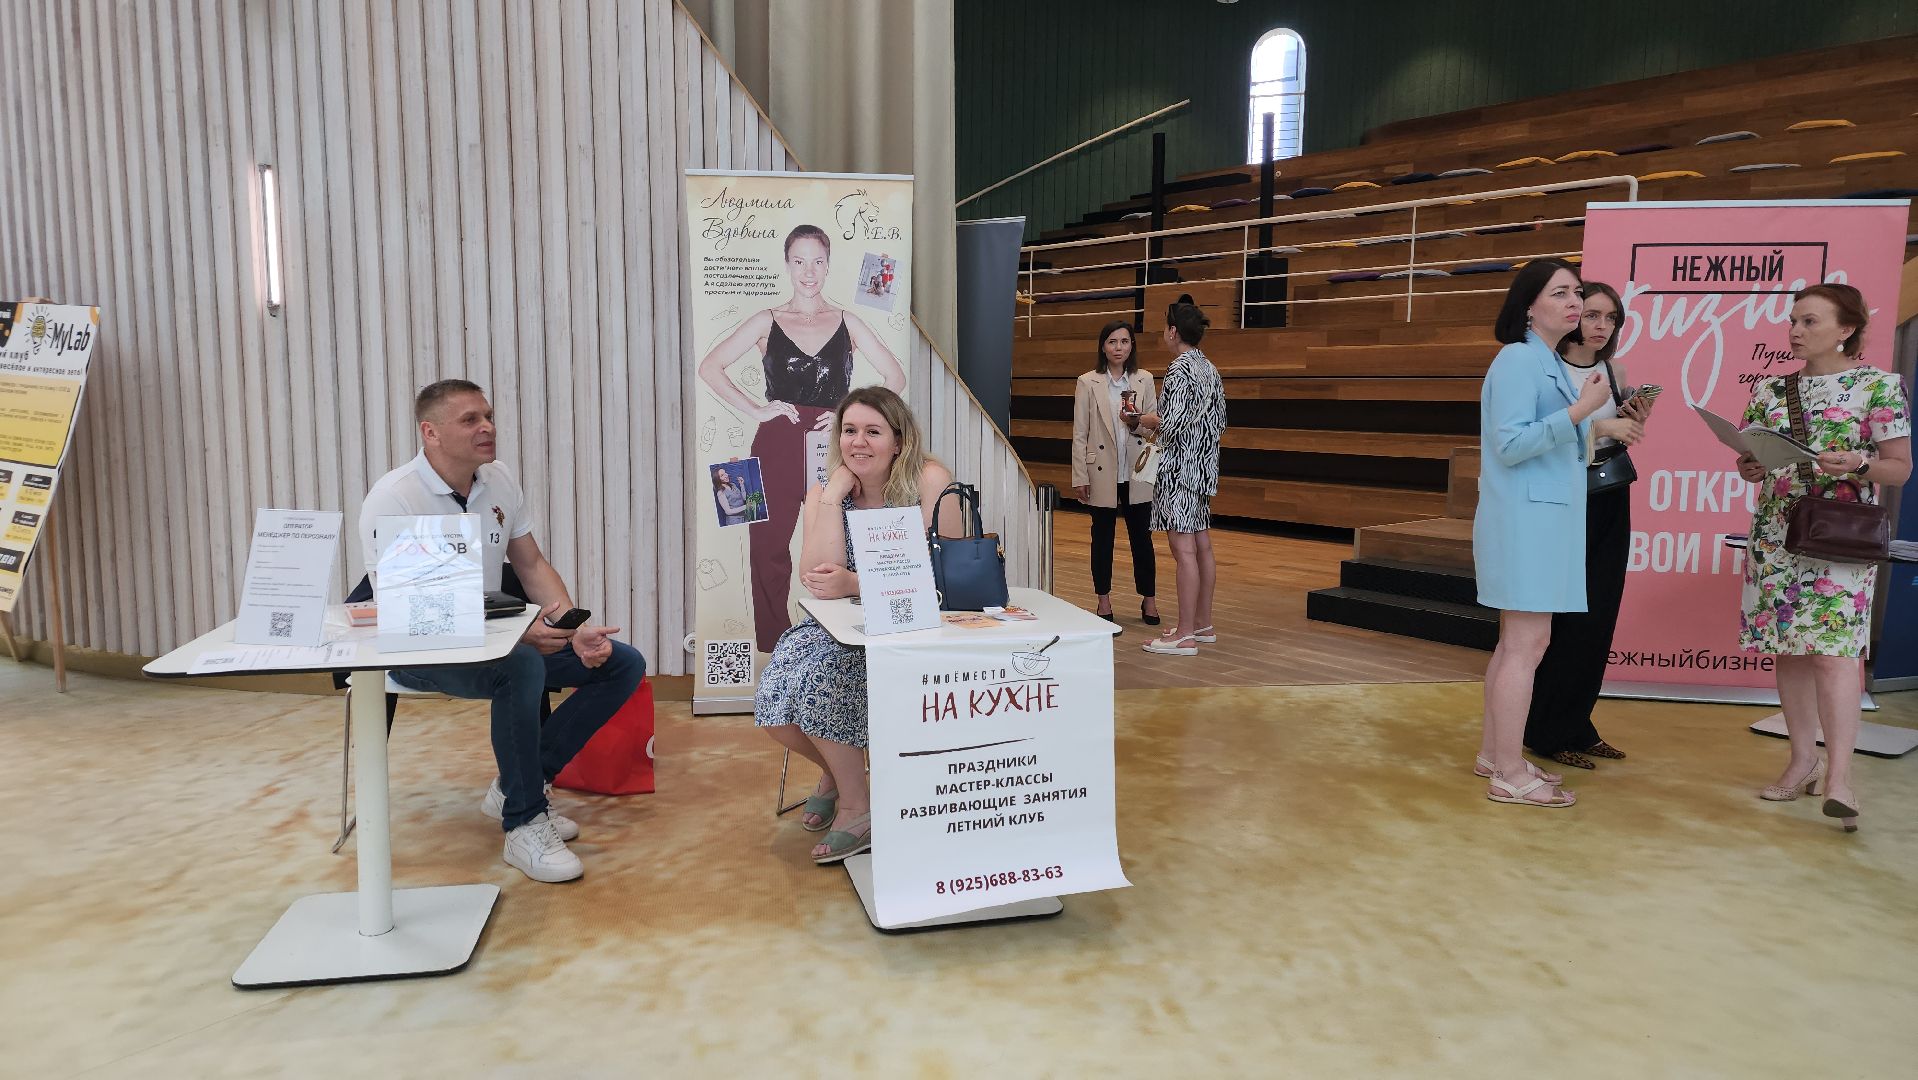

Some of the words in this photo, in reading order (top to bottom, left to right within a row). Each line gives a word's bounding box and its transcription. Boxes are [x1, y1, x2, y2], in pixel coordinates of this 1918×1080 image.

[700, 187, 796, 221] Людмила
[702, 214, 779, 251] Вдовина
[1671, 249, 1785, 282] НЕЖНЫЙ
[49, 322, 91, 356] MyLab
[1837, 393, 1851, 403] 33
[489, 532, 500, 544] 13
[1626, 531, 1701, 574] ВОИ
[1606, 648, 1774, 672] ежныйбизне
[922, 668, 1006, 685] #МОЁМЕСТО
[922, 691, 958, 722] НА
[969, 682, 1060, 718] КУХНЕ
[948, 754, 1037, 775] ПРАЗДНИКИ
[935, 772, 1053, 796] МАСТЕР-КЛАССЫ
[900, 795, 1017, 820] РАЗВИВАЮЩИЕ
[1023, 787, 1087, 805] ЗАНЯТИЯ
[946, 812, 1005, 834] ЛЕТНИЙ
[1008, 811, 1045, 826] КЛУБ
[935, 881, 946, 895] 8
[949, 865, 1064, 895] (925)688-83-63
